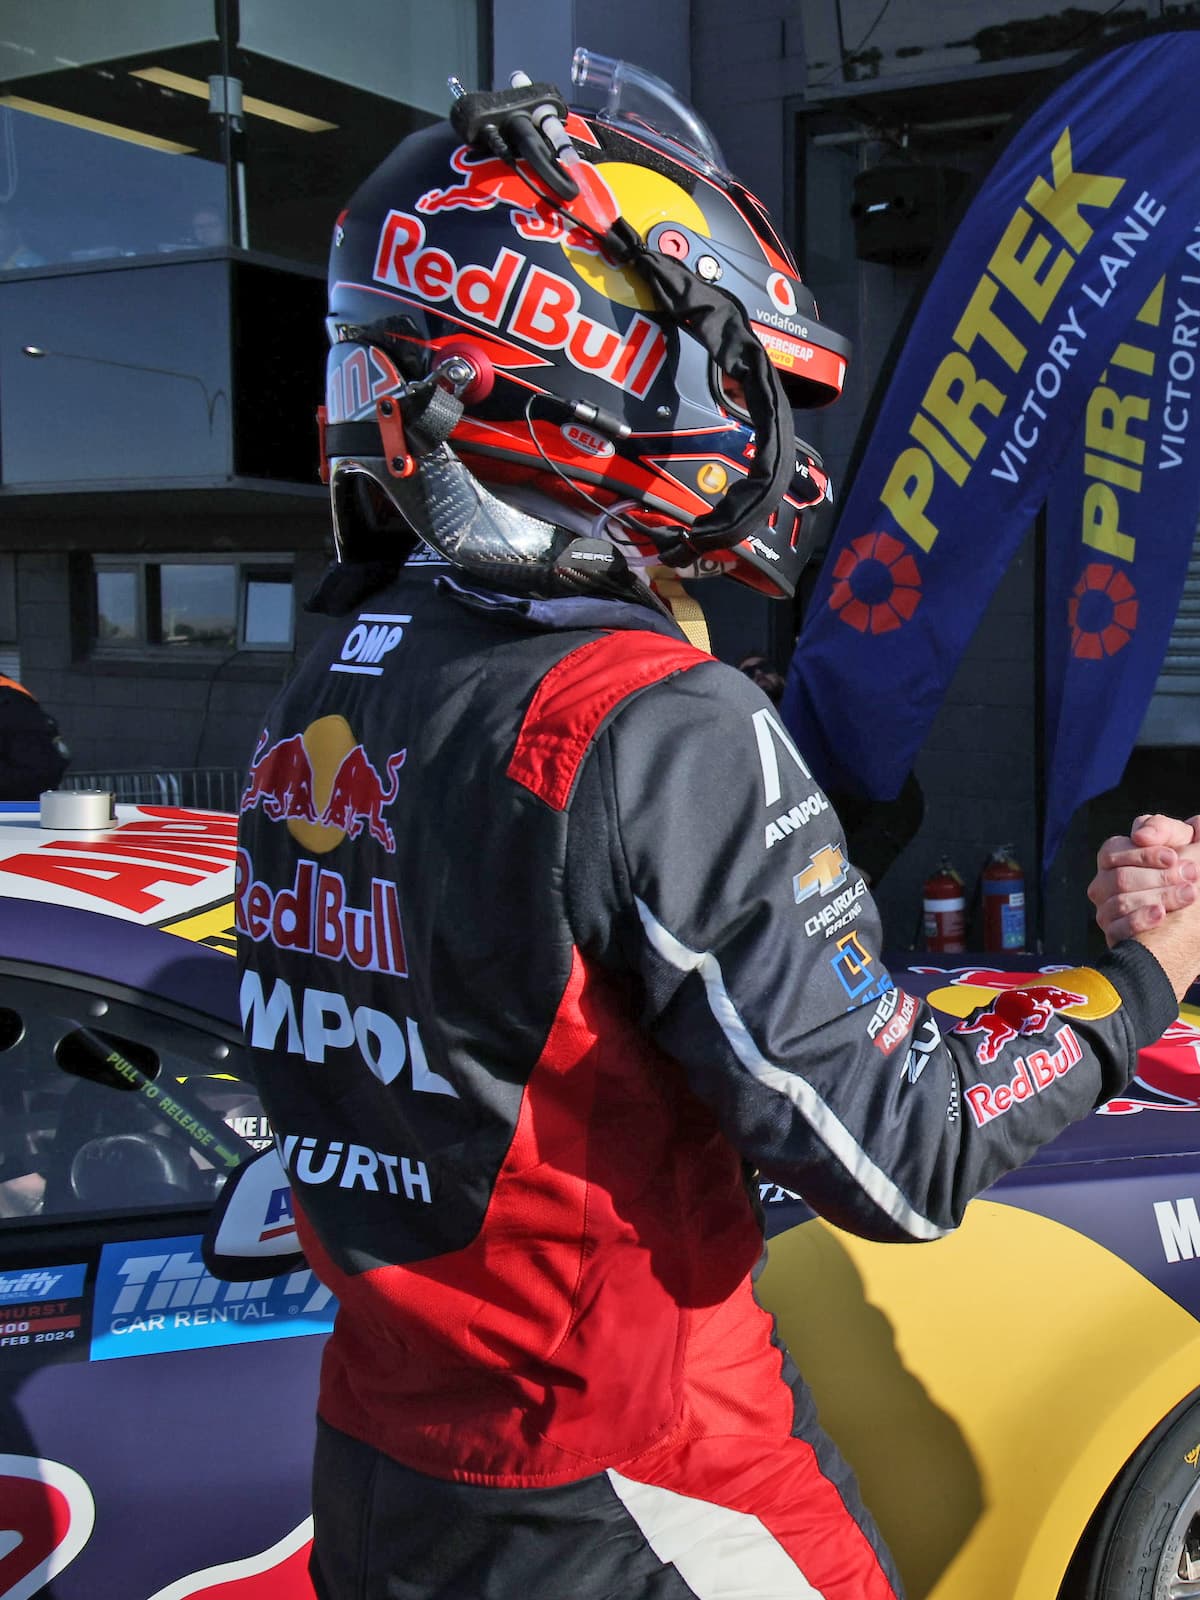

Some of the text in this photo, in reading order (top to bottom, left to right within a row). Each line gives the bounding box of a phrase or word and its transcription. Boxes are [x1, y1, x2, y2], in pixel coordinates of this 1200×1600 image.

[756, 308, 809, 338] vodafone
[880, 126, 1127, 554] PIRTEK
[991, 191, 1167, 485] VICTORY LANE
[1158, 298, 1200, 471] VICTORY
[566, 427, 607, 453] BELL
[340, 624, 404, 664] OMP
[765, 790, 829, 850] AMPOL
[825, 902, 863, 939] RACING
[106, 1051, 215, 1146] PULL TO RELEASE
[110, 1301, 275, 1335] CAR RENTAL
[0, 1330, 76, 1347] FEB 2024
